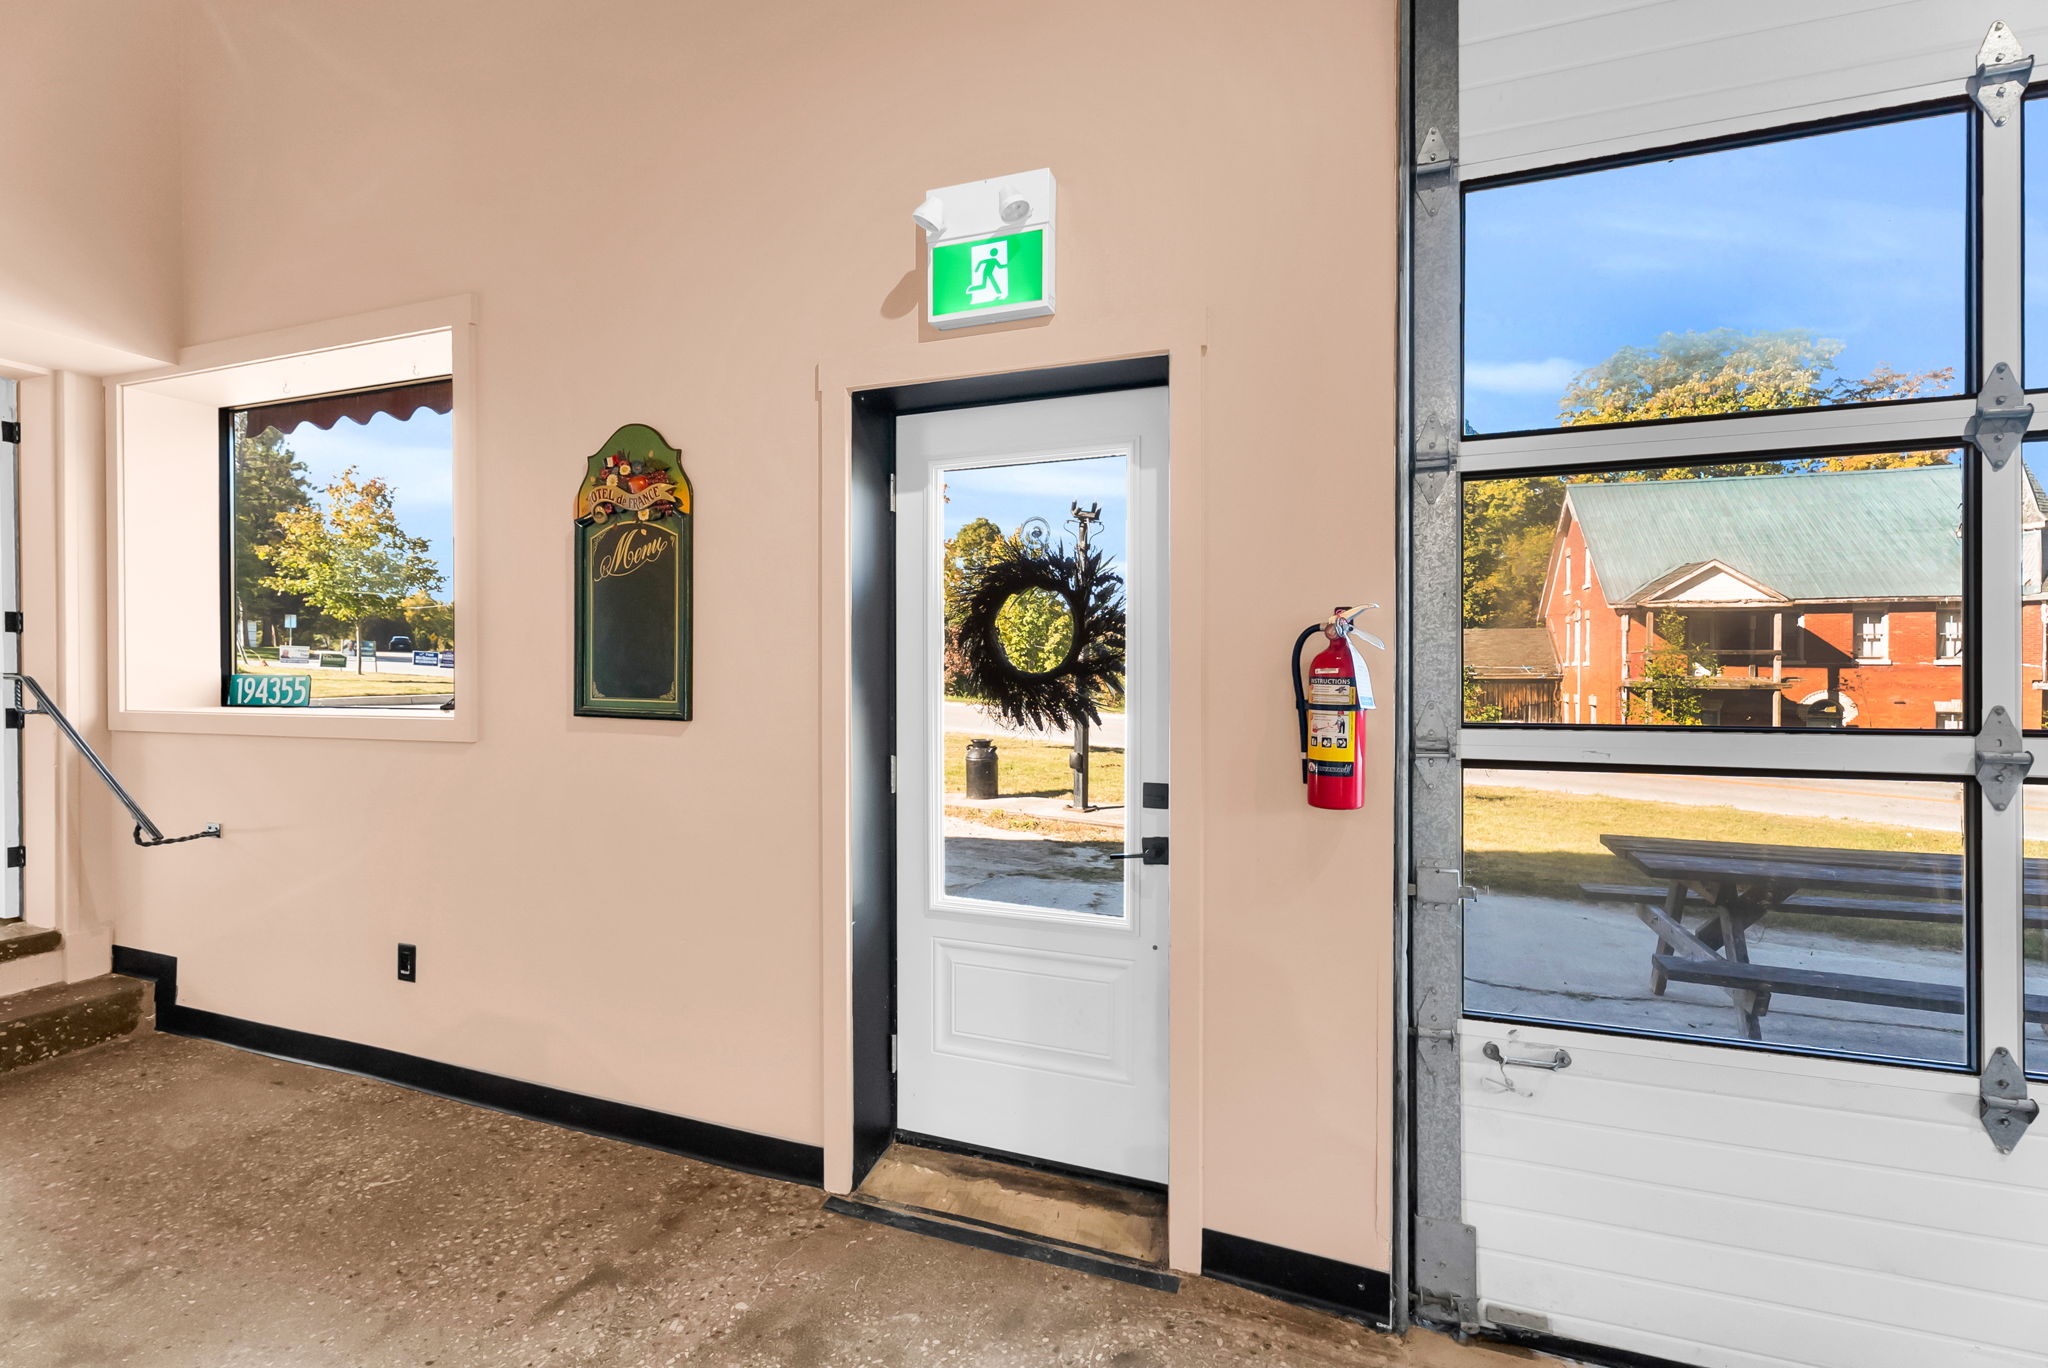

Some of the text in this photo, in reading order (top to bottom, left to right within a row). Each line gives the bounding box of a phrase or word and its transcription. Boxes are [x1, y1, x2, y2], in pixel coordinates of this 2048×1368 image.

[617, 494, 626, 506] de
[629, 486, 660, 509] FRANCE
[594, 529, 667, 581] Menu
[237, 677, 306, 704] 194355
